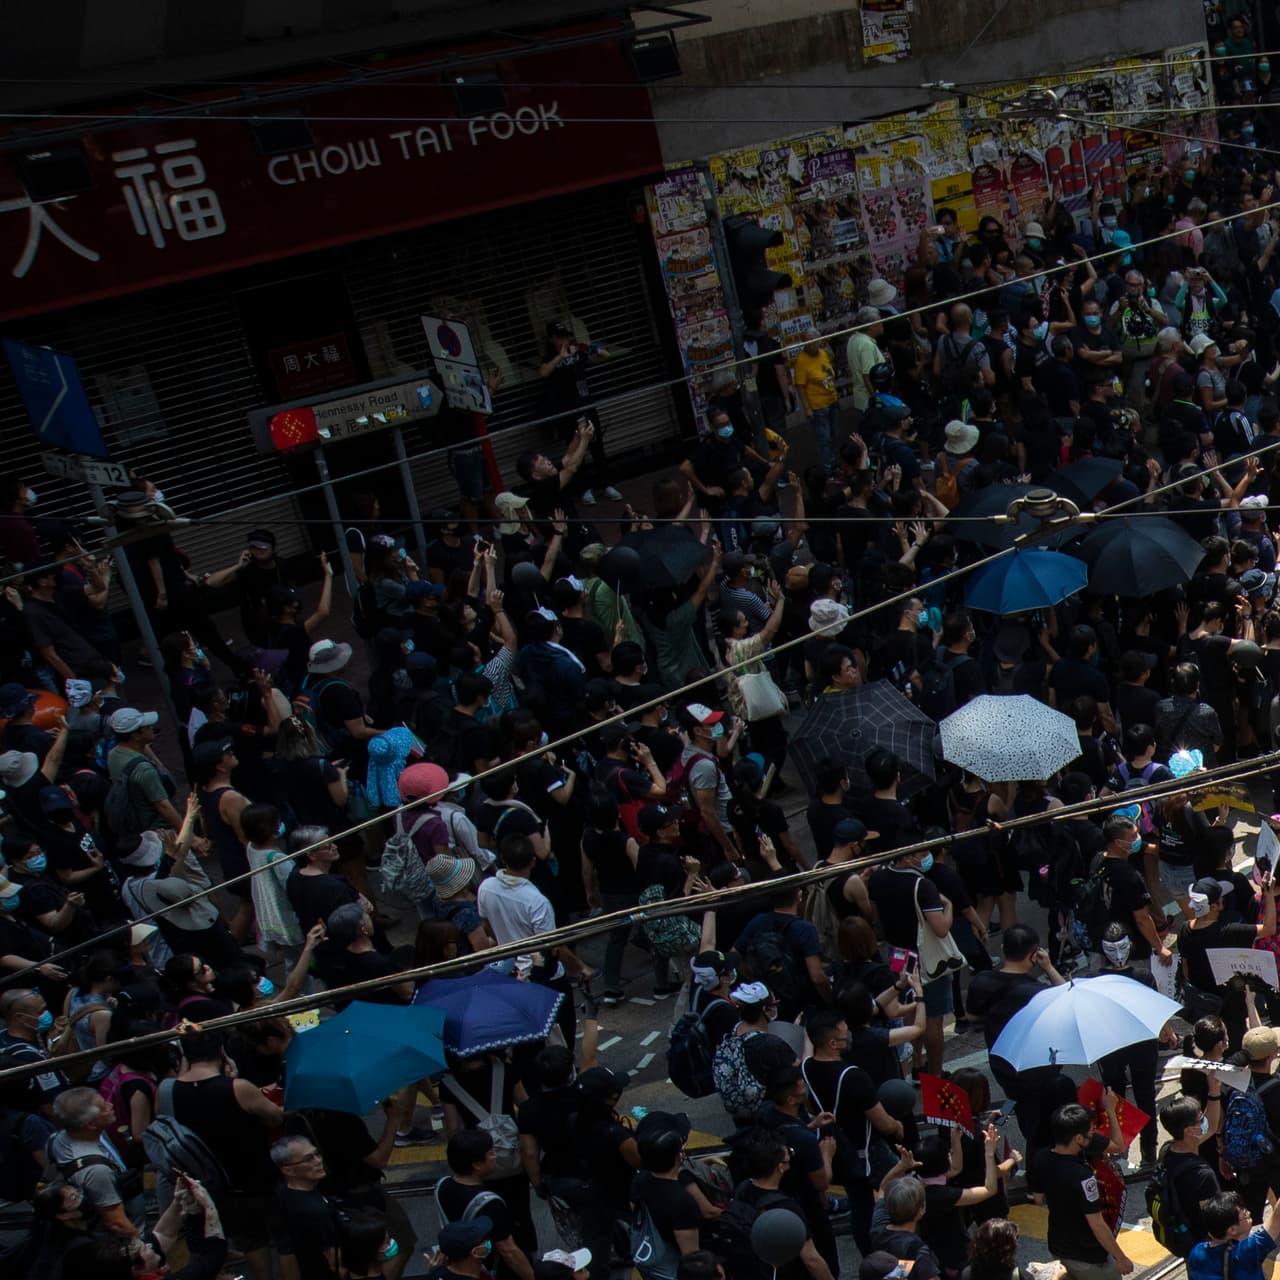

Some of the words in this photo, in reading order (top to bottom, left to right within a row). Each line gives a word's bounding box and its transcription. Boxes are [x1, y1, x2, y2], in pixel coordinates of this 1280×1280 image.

[266, 142, 383, 187] CHOW
[388, 123, 454, 160] TAI
[468, 100, 566, 148] FOOK
[313, 399, 366, 419] Hennessy
[368, 392, 399, 408] Road
